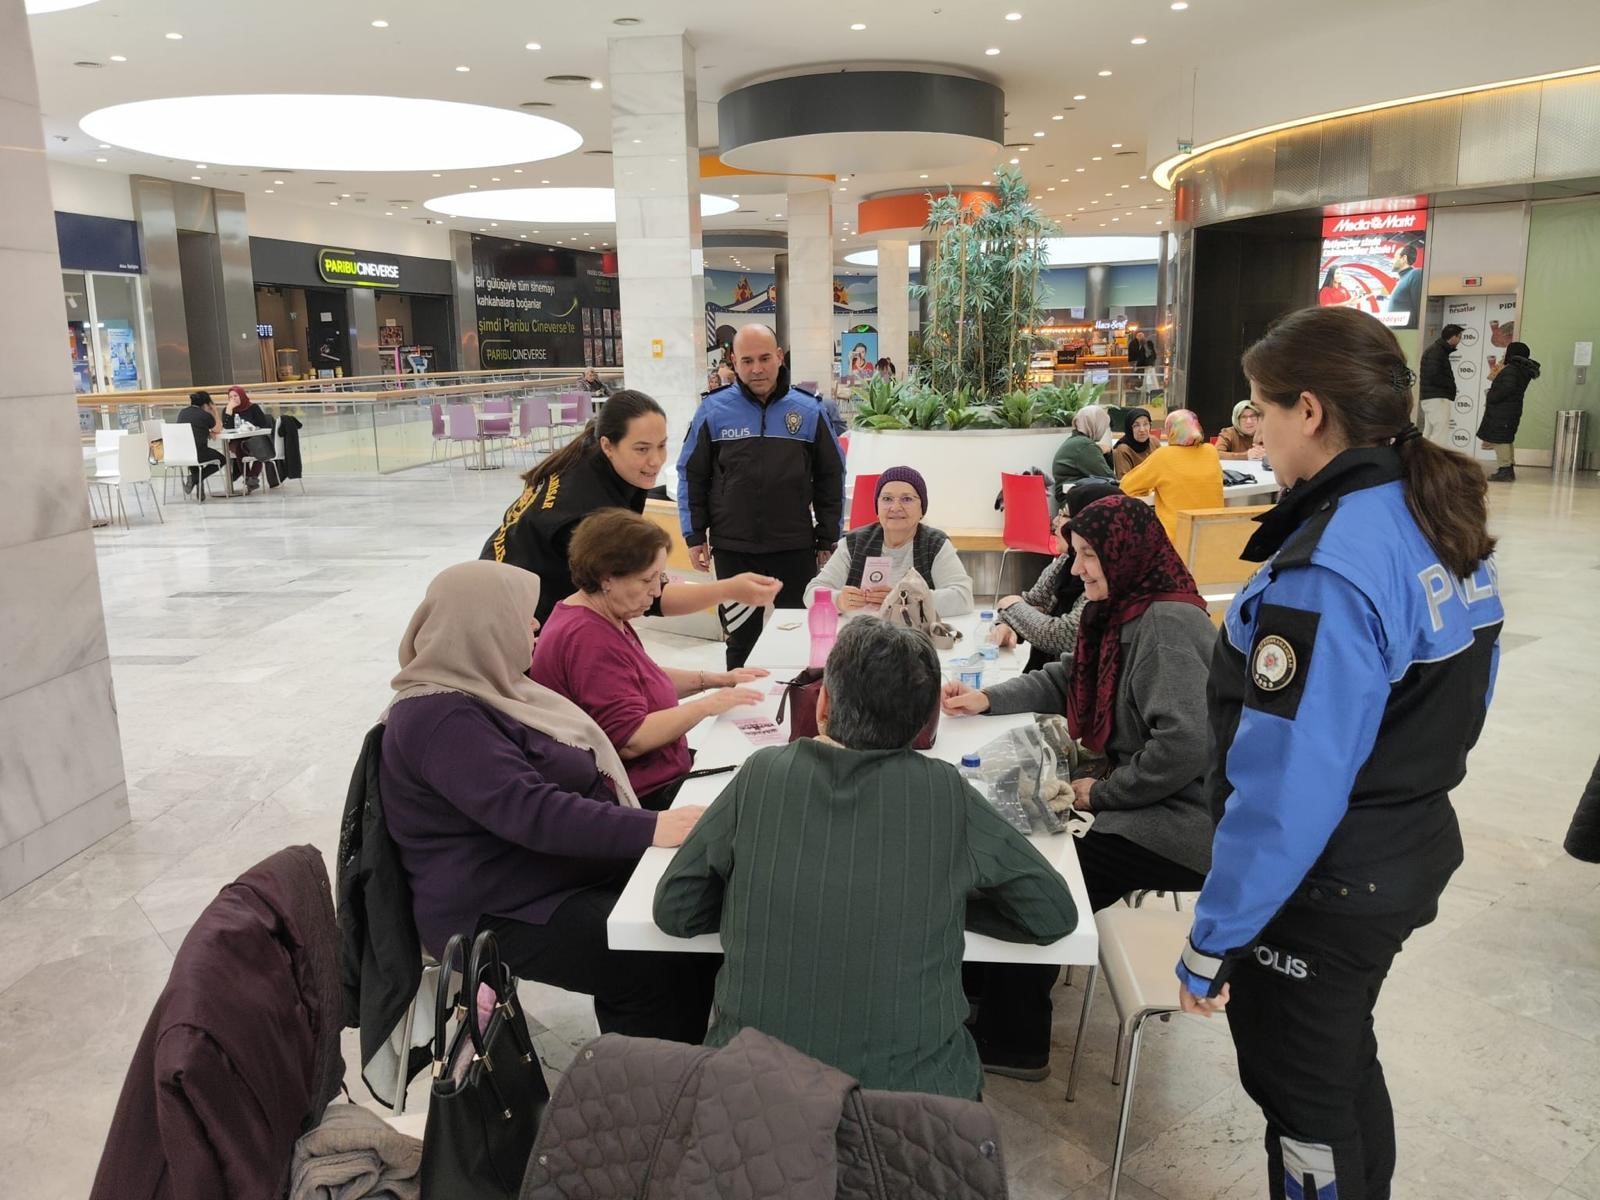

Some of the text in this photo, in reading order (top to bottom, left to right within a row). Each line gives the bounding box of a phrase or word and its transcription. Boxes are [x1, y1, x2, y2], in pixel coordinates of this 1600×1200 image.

[475, 276, 556, 296] Bir gülüşüyle tüm sinemayı
[476, 294, 542, 311] kahkahalara boğanlar
[478, 317, 576, 335] şimdi Paribu Cineverse'te
